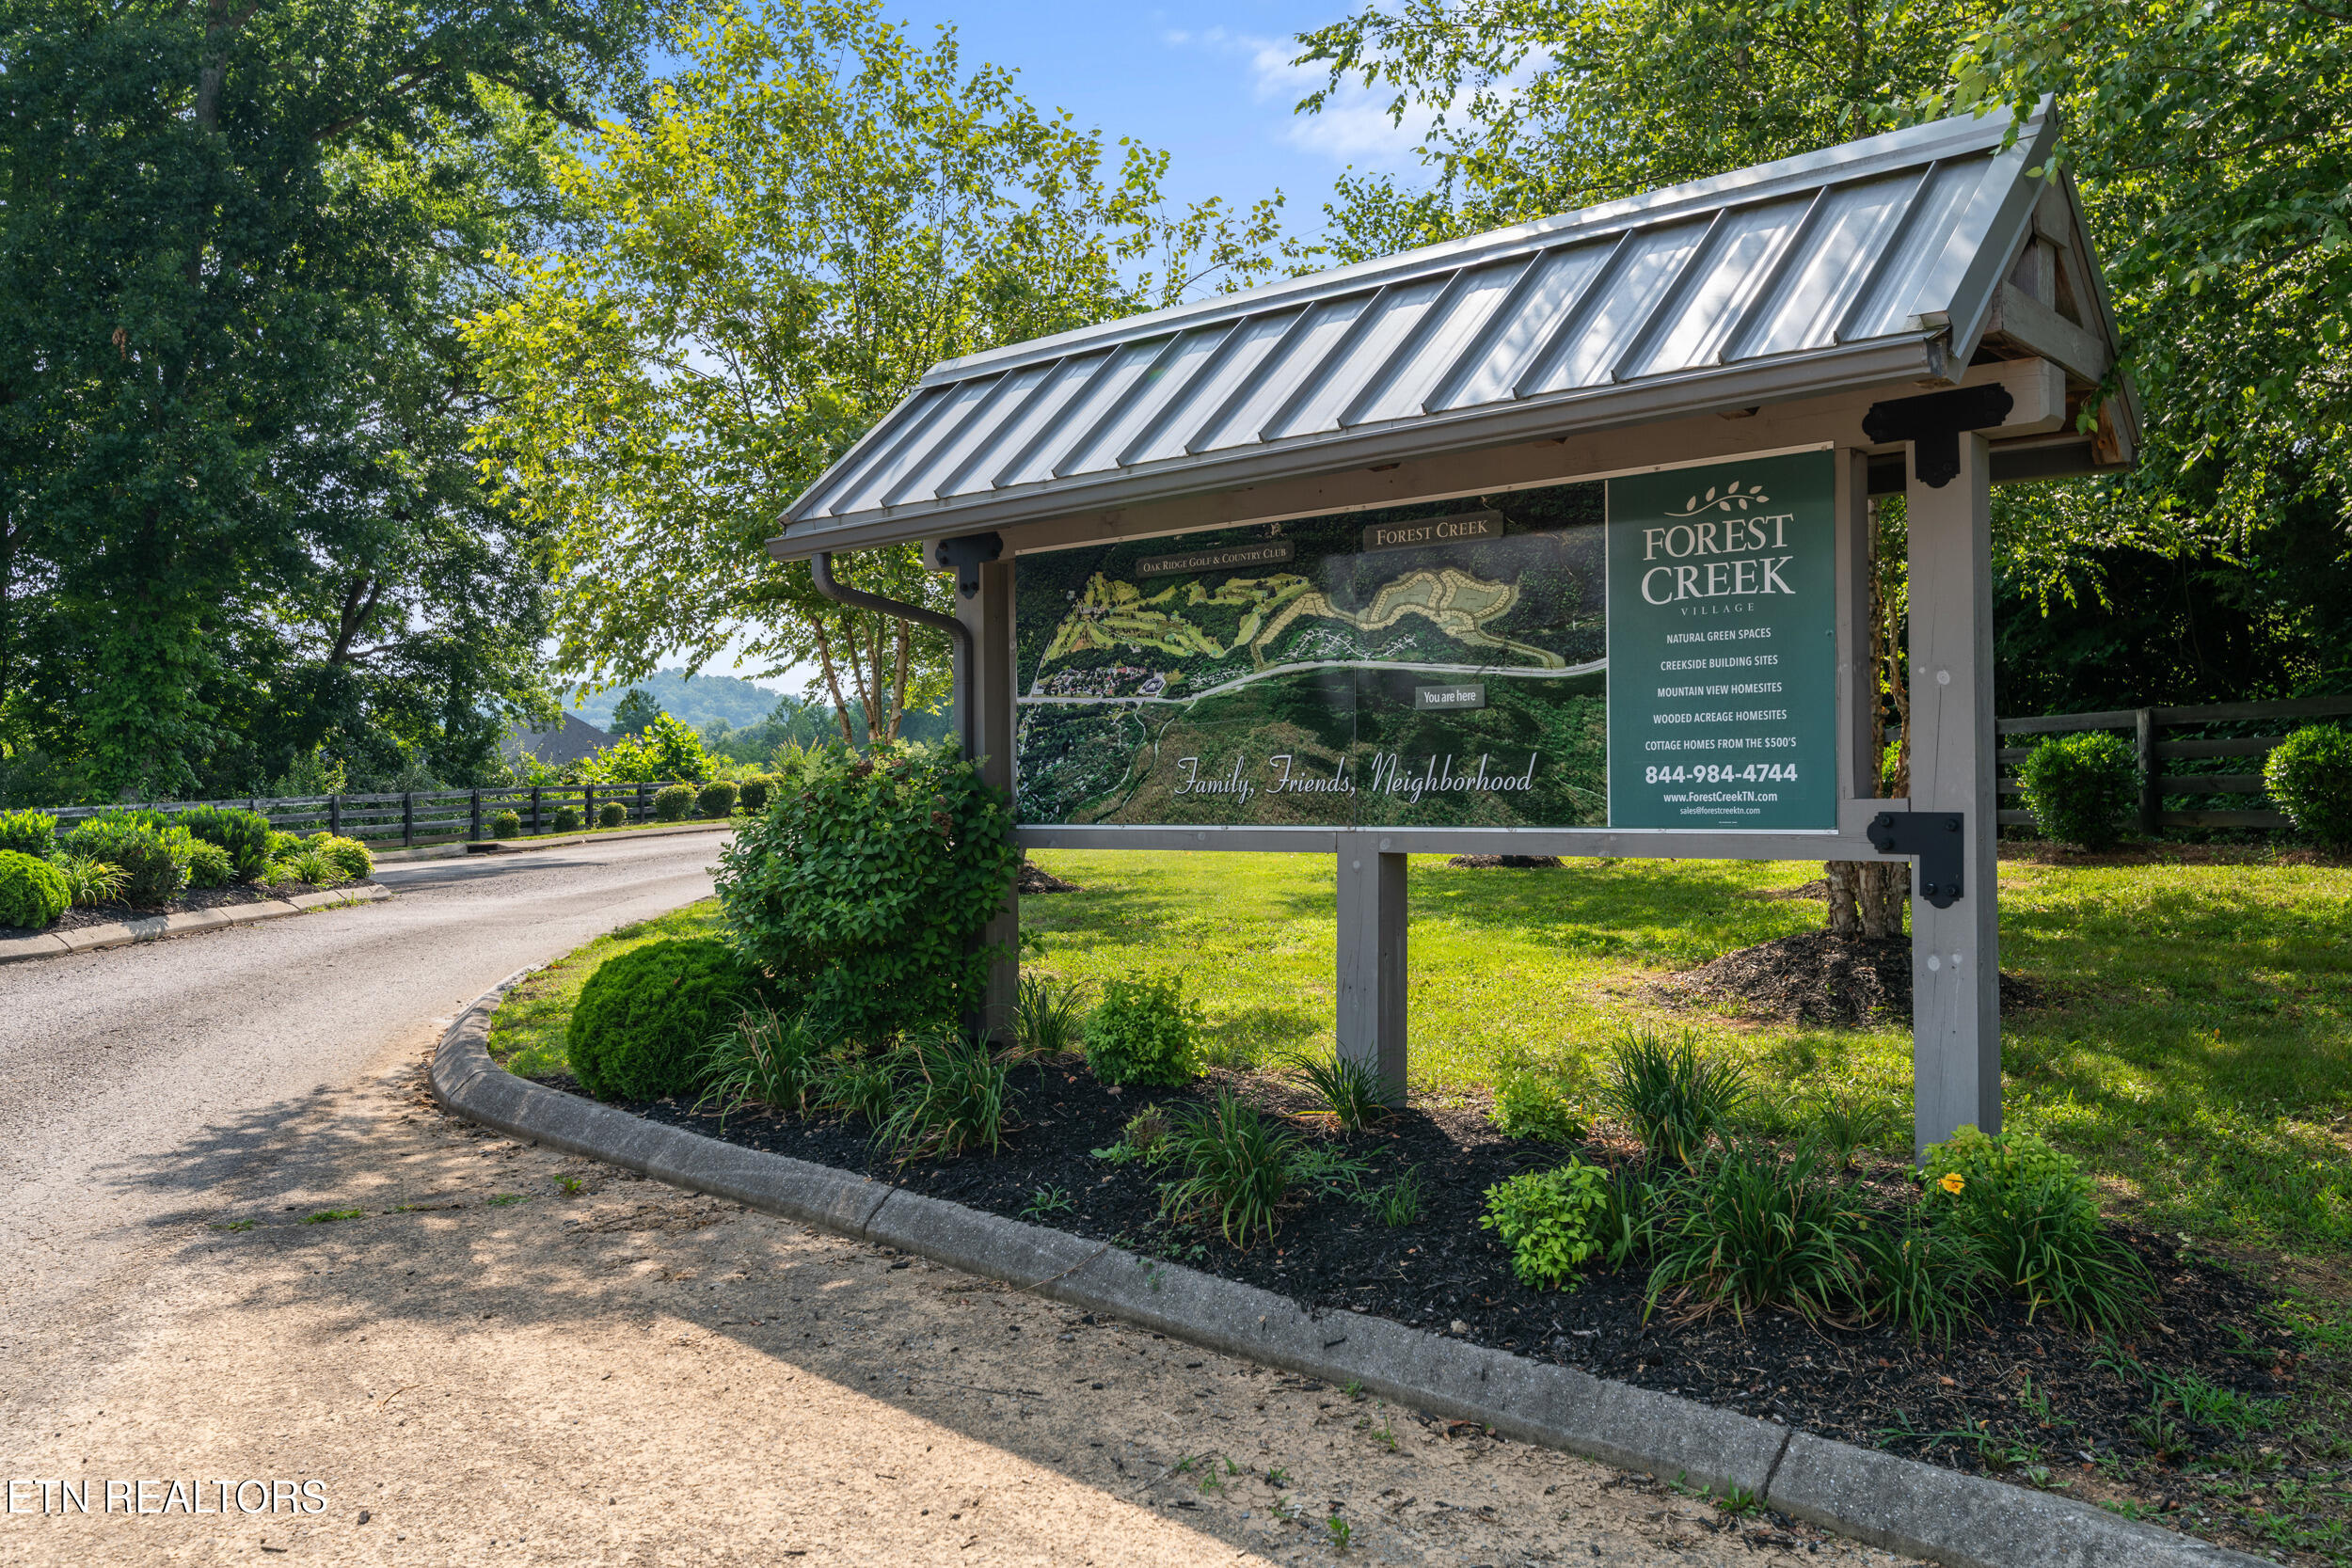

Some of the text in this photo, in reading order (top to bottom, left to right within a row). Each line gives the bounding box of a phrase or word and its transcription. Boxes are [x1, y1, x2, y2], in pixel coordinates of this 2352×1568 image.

[1375, 518, 1488, 546] FOREST CREEK
[1642, 513, 1794, 562] FOREST
[1143, 547, 1287, 573] OAK RIDGE GOLF & COUNTRY CLUB
[1641, 555, 1796, 606] CREEK
[1680, 602, 1756, 616] VILLAGE
[1666, 627, 1772, 644] NATURAL GREEN SPACES
[1661, 655, 1778, 671] CREEKSIDE BUILDING SITES
[1423, 690, 1476, 704] You are here
[1657, 682, 1783, 698] MOUNTAIN VIEW HOMESITES
[1653, 709, 1788, 724] WOODED ACREAGE HOMESITES
[1645, 740, 1681, 751] COTTAGE
[1683, 738, 1715, 751] HOMES
[1717, 738, 1743, 749] FROM
[1745, 737, 1762, 749] THE
[1174, 752, 1538, 805] Family, Friends, Neighborhood
[1645, 764, 1798, 784] 844-984-4744
[1663, 791, 1778, 802] www.ForestCreekTN.com
[1679, 806, 1761, 816] sales@forestcreektn.com
